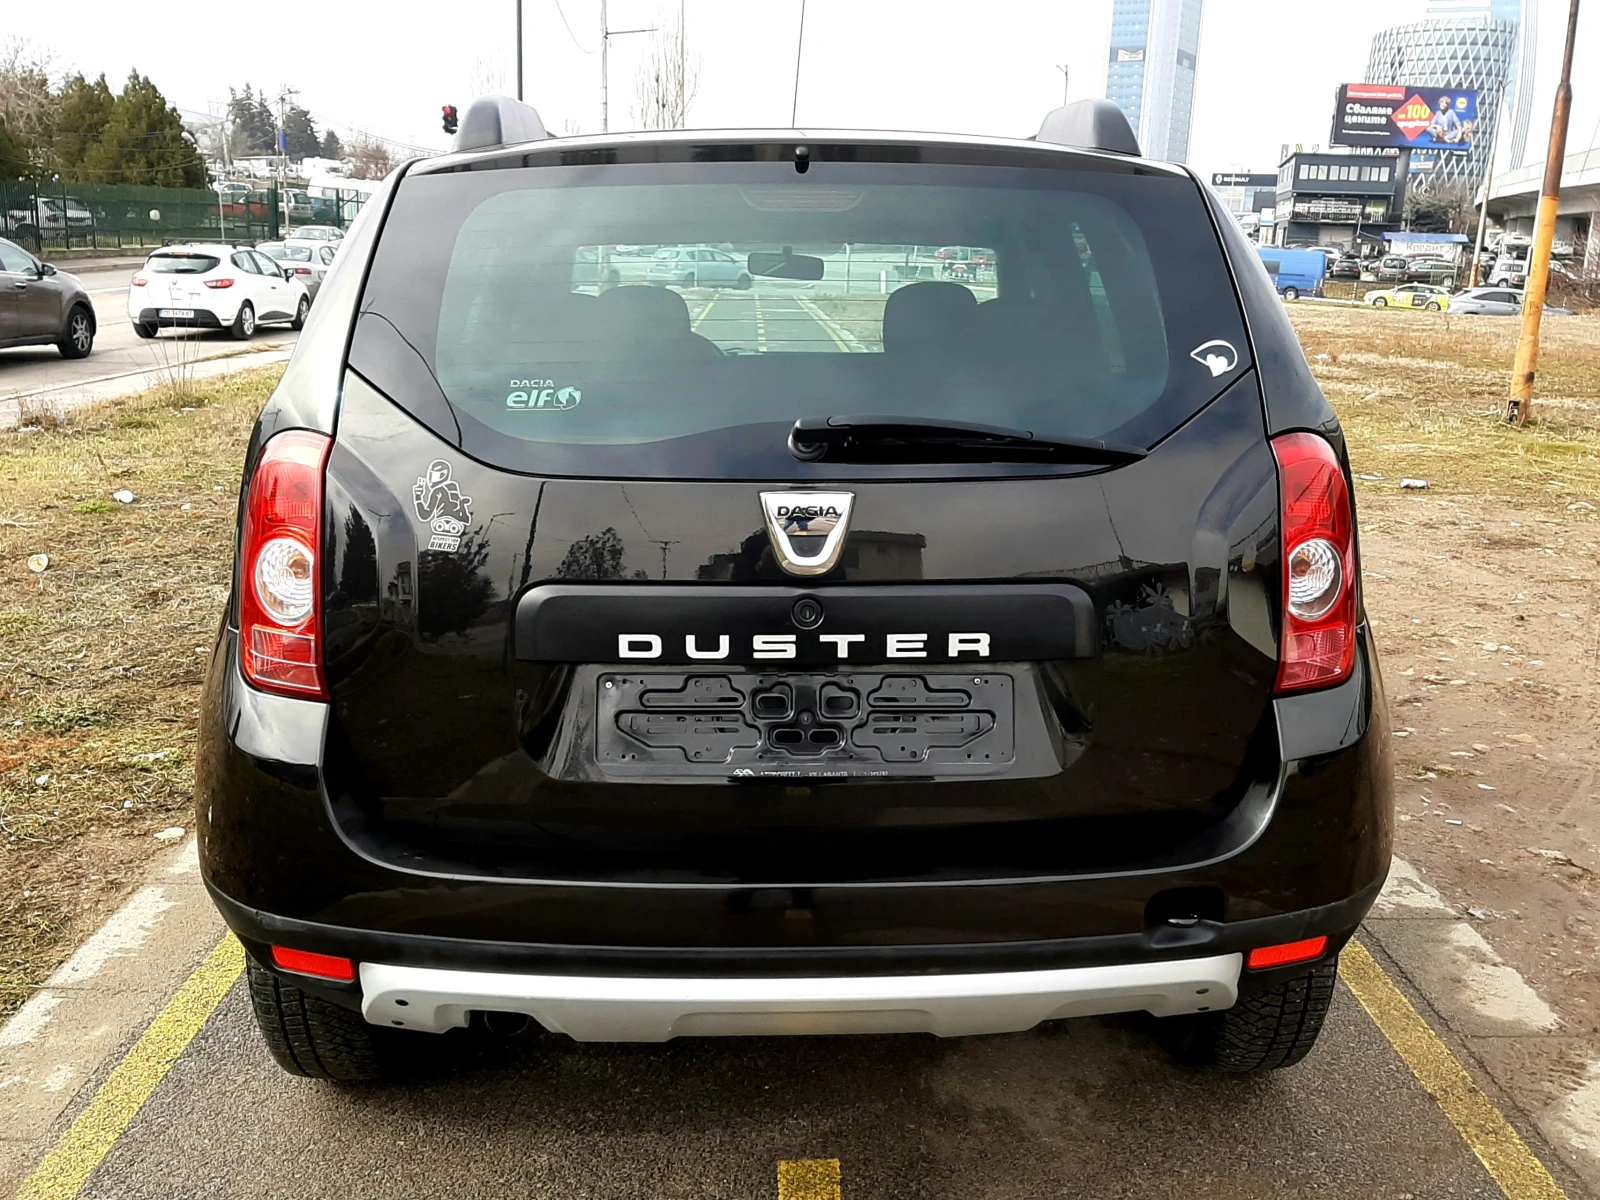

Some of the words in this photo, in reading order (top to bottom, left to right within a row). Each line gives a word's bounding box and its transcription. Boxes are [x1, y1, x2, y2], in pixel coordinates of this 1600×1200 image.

[1346, 103, 1393, 115] Сваляме
[1407, 104, 1431, 119] 100
[1344, 115, 1387, 125] цените
[510, 379, 555, 388] DACIA
[506, 389, 554, 408] elf
[777, 506, 838, 517] DACIA
[430, 541, 458, 551] BIKERS
[618, 632, 991, 659] DUSTER
